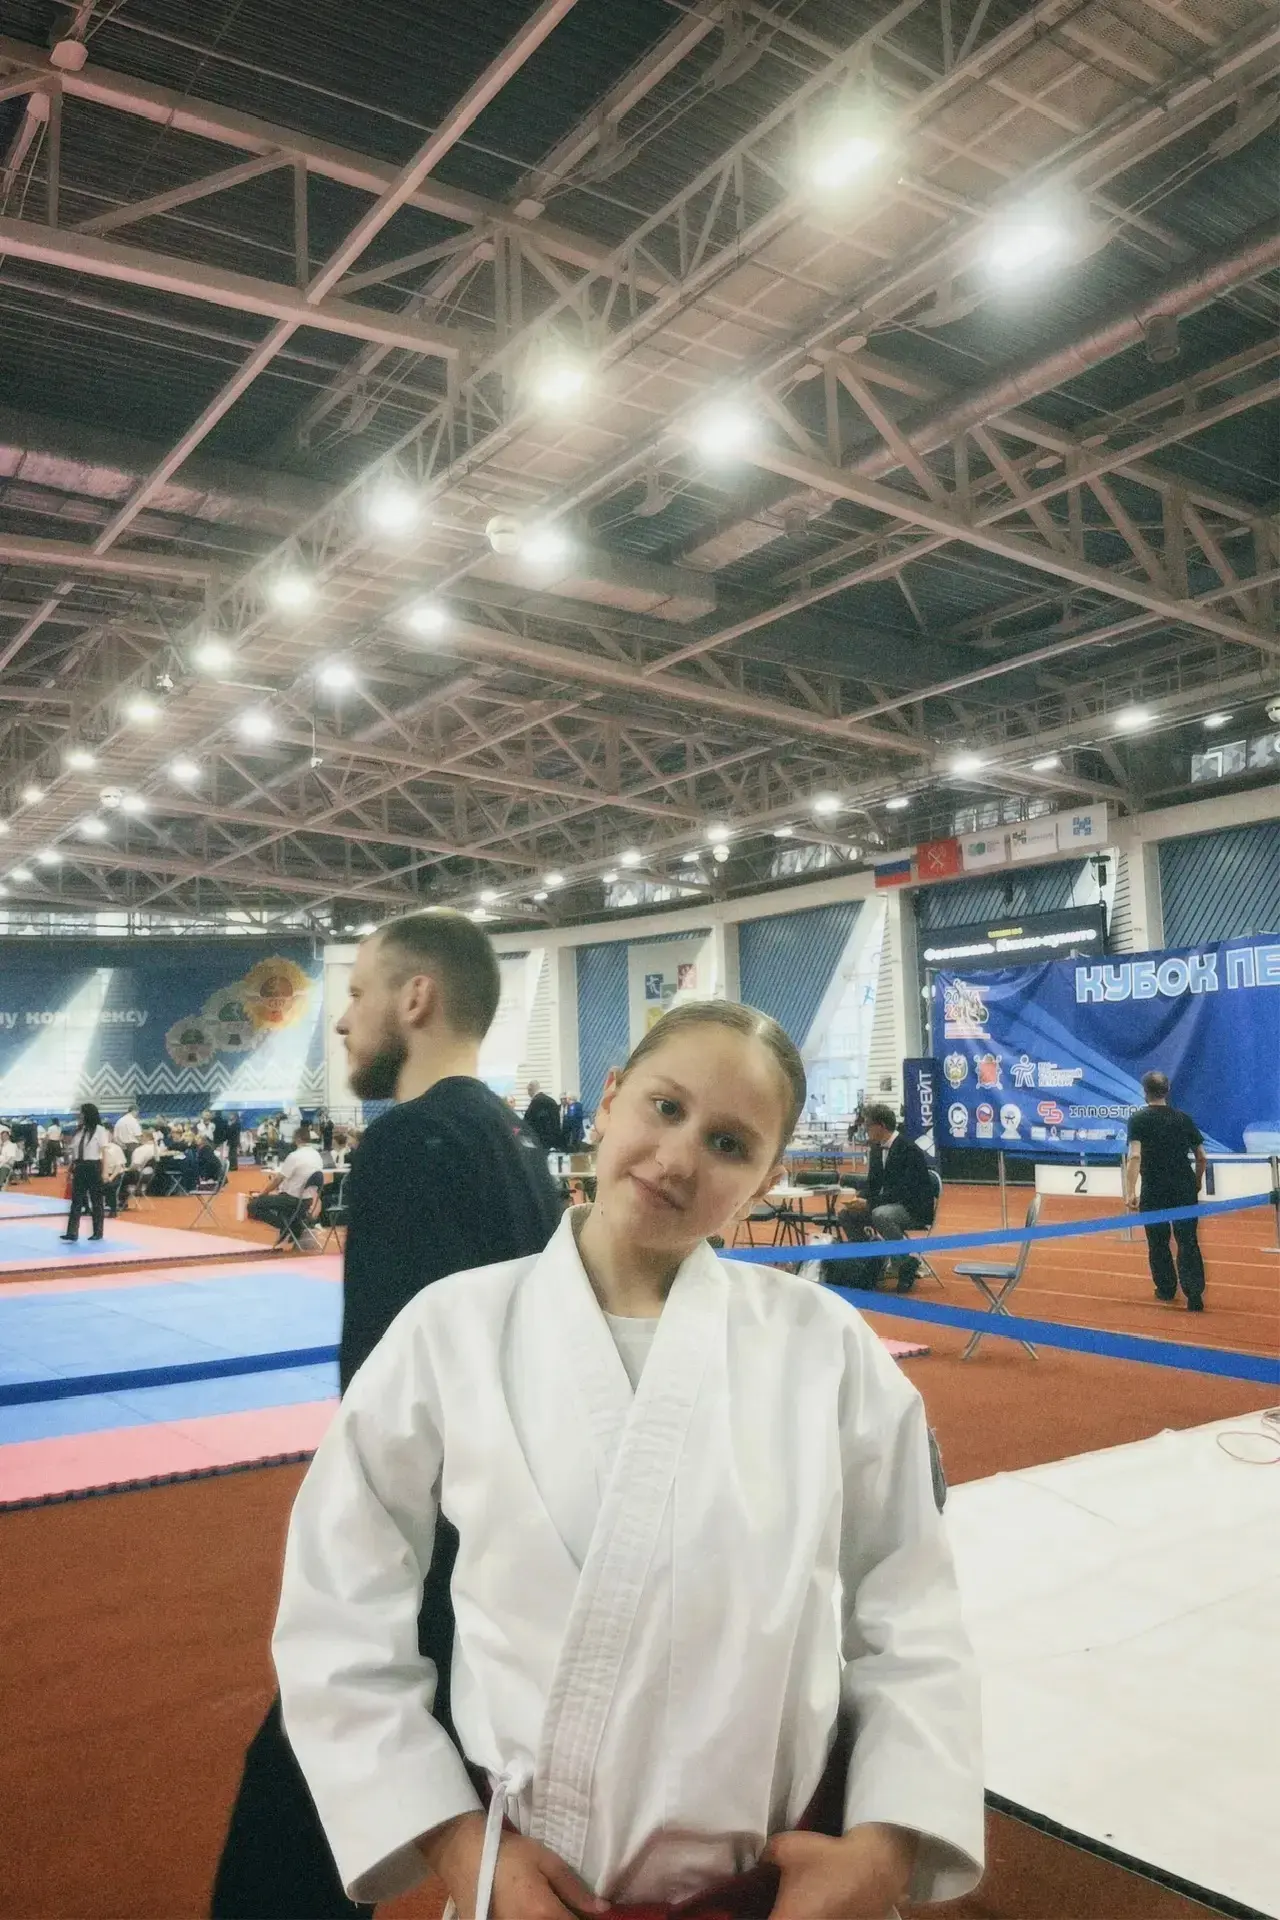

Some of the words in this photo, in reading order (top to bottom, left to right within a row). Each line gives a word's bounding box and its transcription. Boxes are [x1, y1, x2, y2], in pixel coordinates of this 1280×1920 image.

[1075, 952, 1219, 1003] КУБОК
[917, 1069, 934, 1127] КРЕЙТ
[1073, 1170, 1088, 1193] 2
